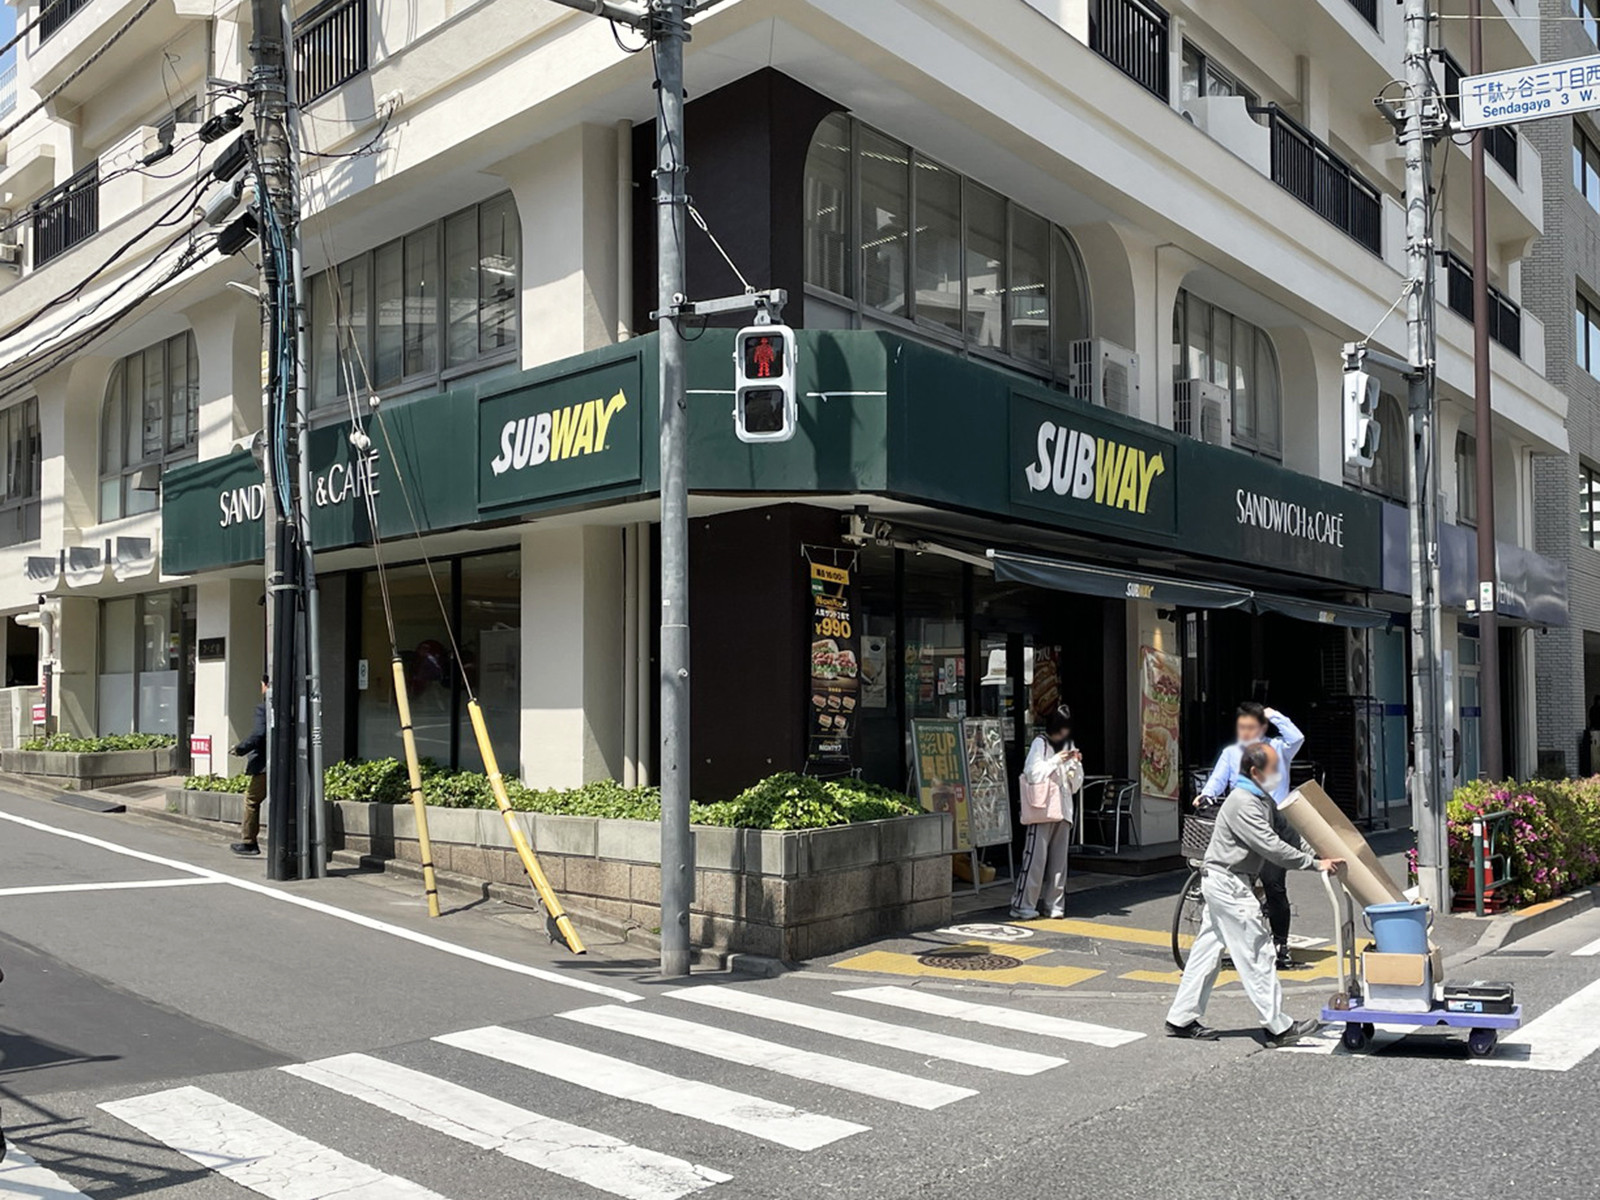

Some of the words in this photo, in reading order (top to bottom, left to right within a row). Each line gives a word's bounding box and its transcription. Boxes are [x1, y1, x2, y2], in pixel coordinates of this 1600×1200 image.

[1472, 65, 1600, 106] 千駄ヶ谷三丁目西
[1483, 99, 1551, 118] Sendagaya
[1560, 93, 1570, 105] 3
[1579, 89, 1598, 102] W.
[491, 388, 627, 477] SUBWAY
[1025, 421, 1165, 514] SUBWAY
[1125, 582, 1154, 598] SUBWAY
[815, 617, 852, 639] ¥990
